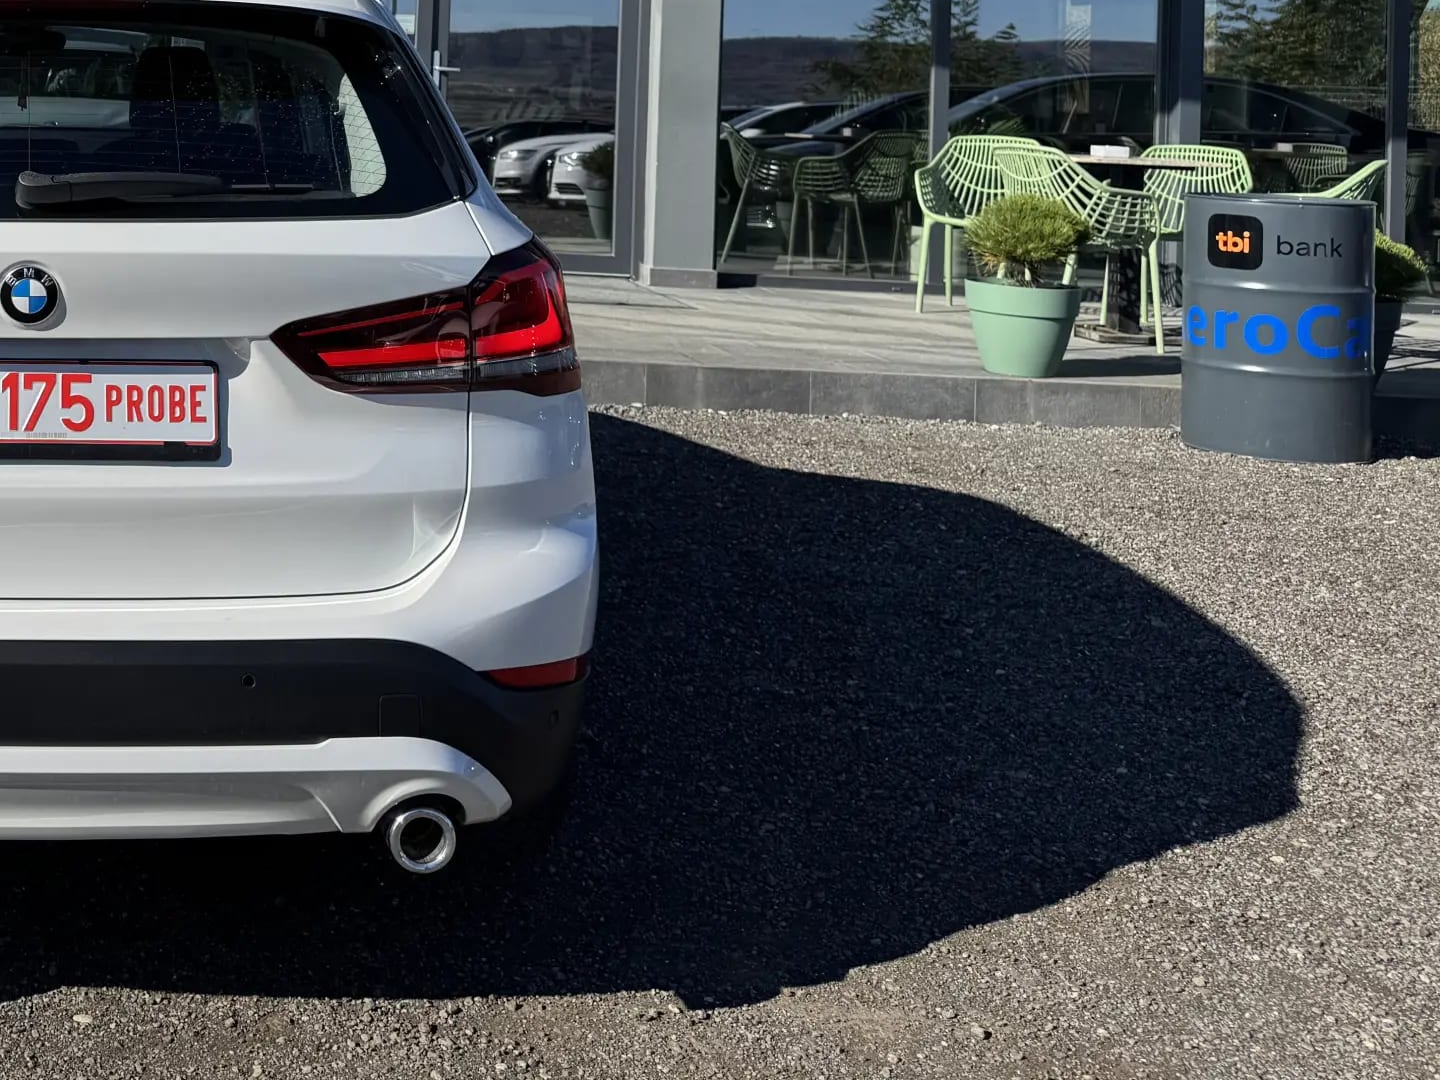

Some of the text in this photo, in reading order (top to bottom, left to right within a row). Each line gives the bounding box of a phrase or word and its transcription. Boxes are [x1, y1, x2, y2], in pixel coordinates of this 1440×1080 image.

[1215, 229, 1343, 259] tbi bank
[5, 267, 54, 287] BMW
[1, 371, 95, 433] 175
[105, 384, 208, 423] PROBE
